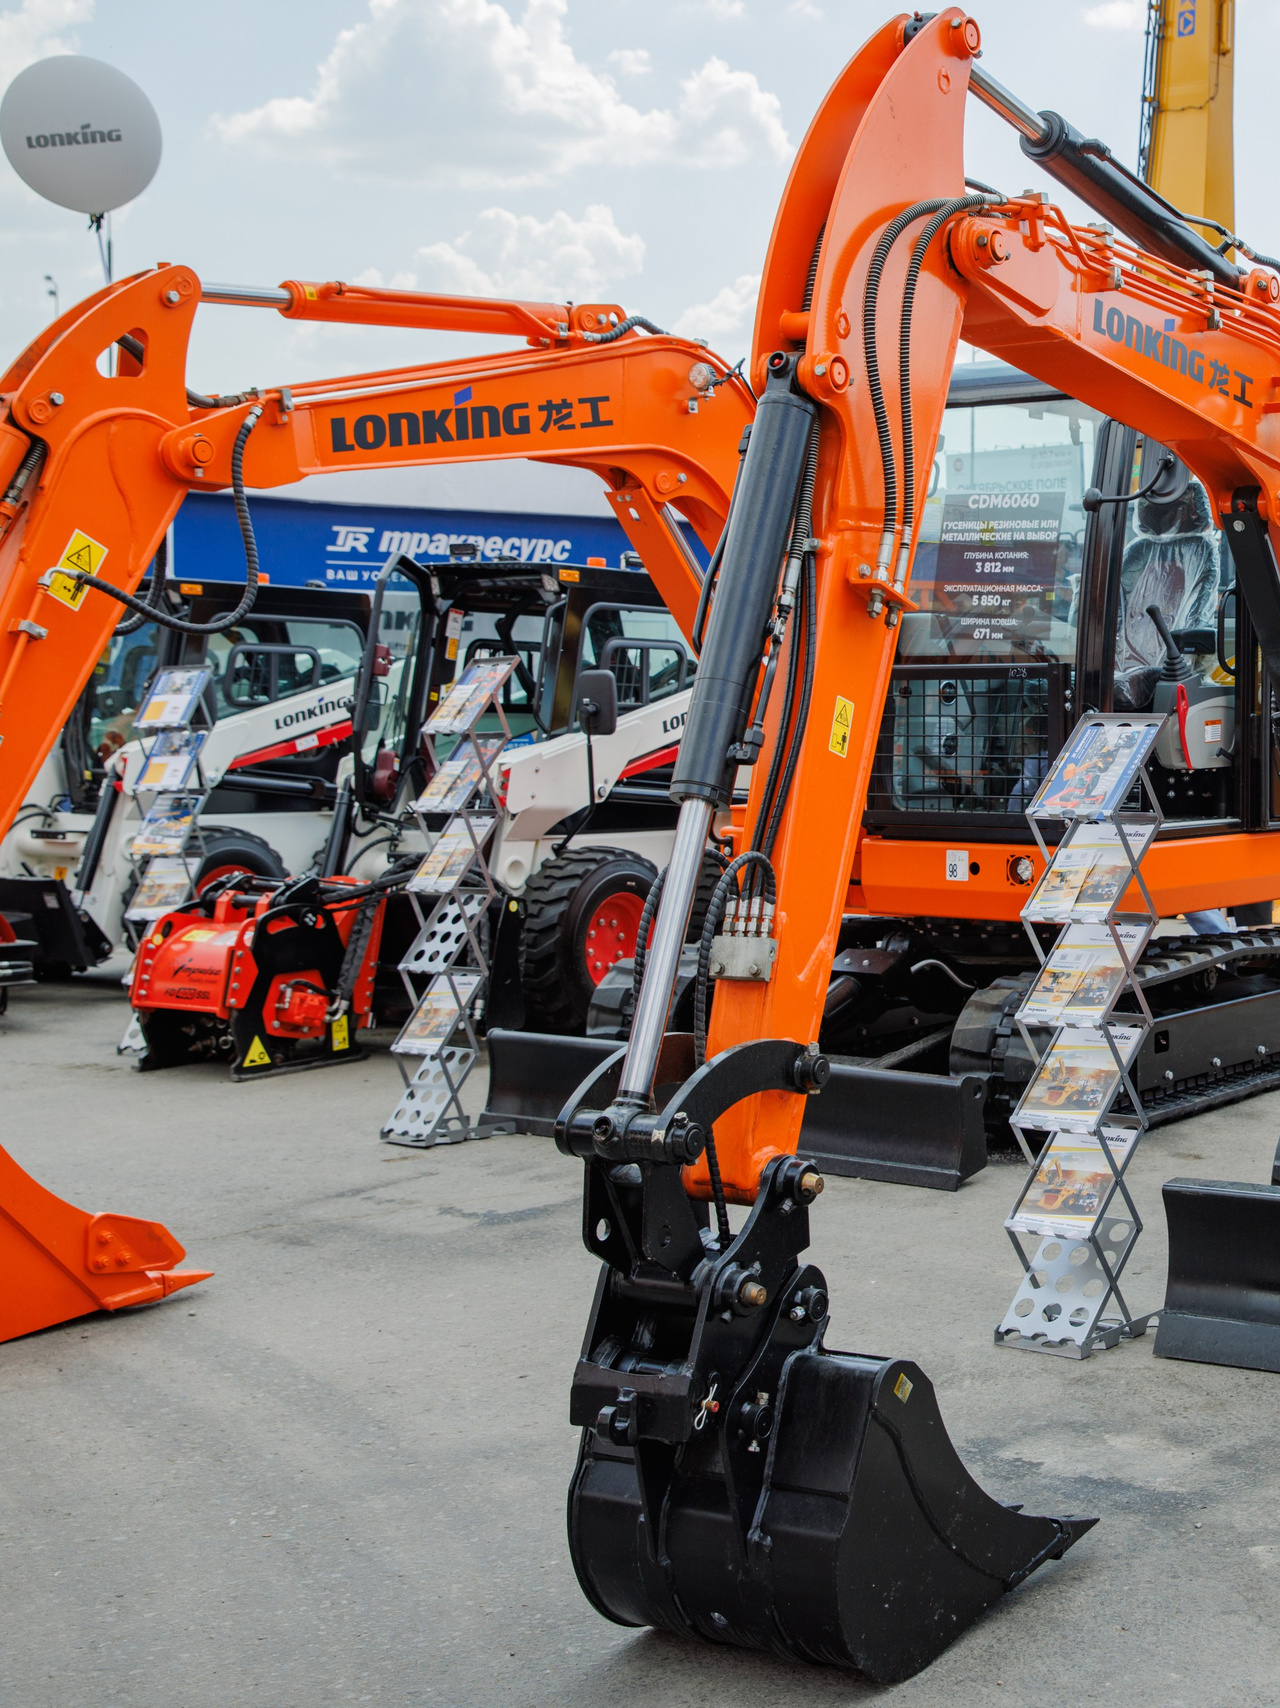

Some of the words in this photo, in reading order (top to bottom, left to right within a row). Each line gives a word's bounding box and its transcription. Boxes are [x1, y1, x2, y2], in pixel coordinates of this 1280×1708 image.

[1093, 298, 1205, 384] LONKING
[1208, 358, 1254, 409] 龙工
[330, 386, 531, 453] LONKING
[538, 396, 614, 433] 龙工
[1036, 477, 1067, 490] ПОЛЕ
[968, 493, 1040, 509] CDM6060
[943, 520, 987, 530] ГУСЕНИЦЫ
[989, 520, 1039, 529] РЕЗИНОВЫЕ
[1041, 520, 1059, 529] ИЛИ
[941, 532, 1012, 541] МЕТАЛЛИЧЕСКИЕ
[1013, 532, 1024, 540] НА
[1027, 531, 1057, 540] ВЫБОР
[975, 562, 982, 573] 3
[984, 562, 1001, 573] 812
[326, 569, 358, 580] ВАШ
[361, 570, 409, 583] УСЕХ
[943, 585, 1015, 593] ЭКСПЛУАТАЦИОННАЯ
[972, 595, 979, 606] 5
[980, 595, 1001, 606] 850
[1002, 598, 1011, 606] кг
[960, 618, 990, 626] ШИРИНА
[973, 628, 990, 639] 671
[948, 863, 958, 878] 98
